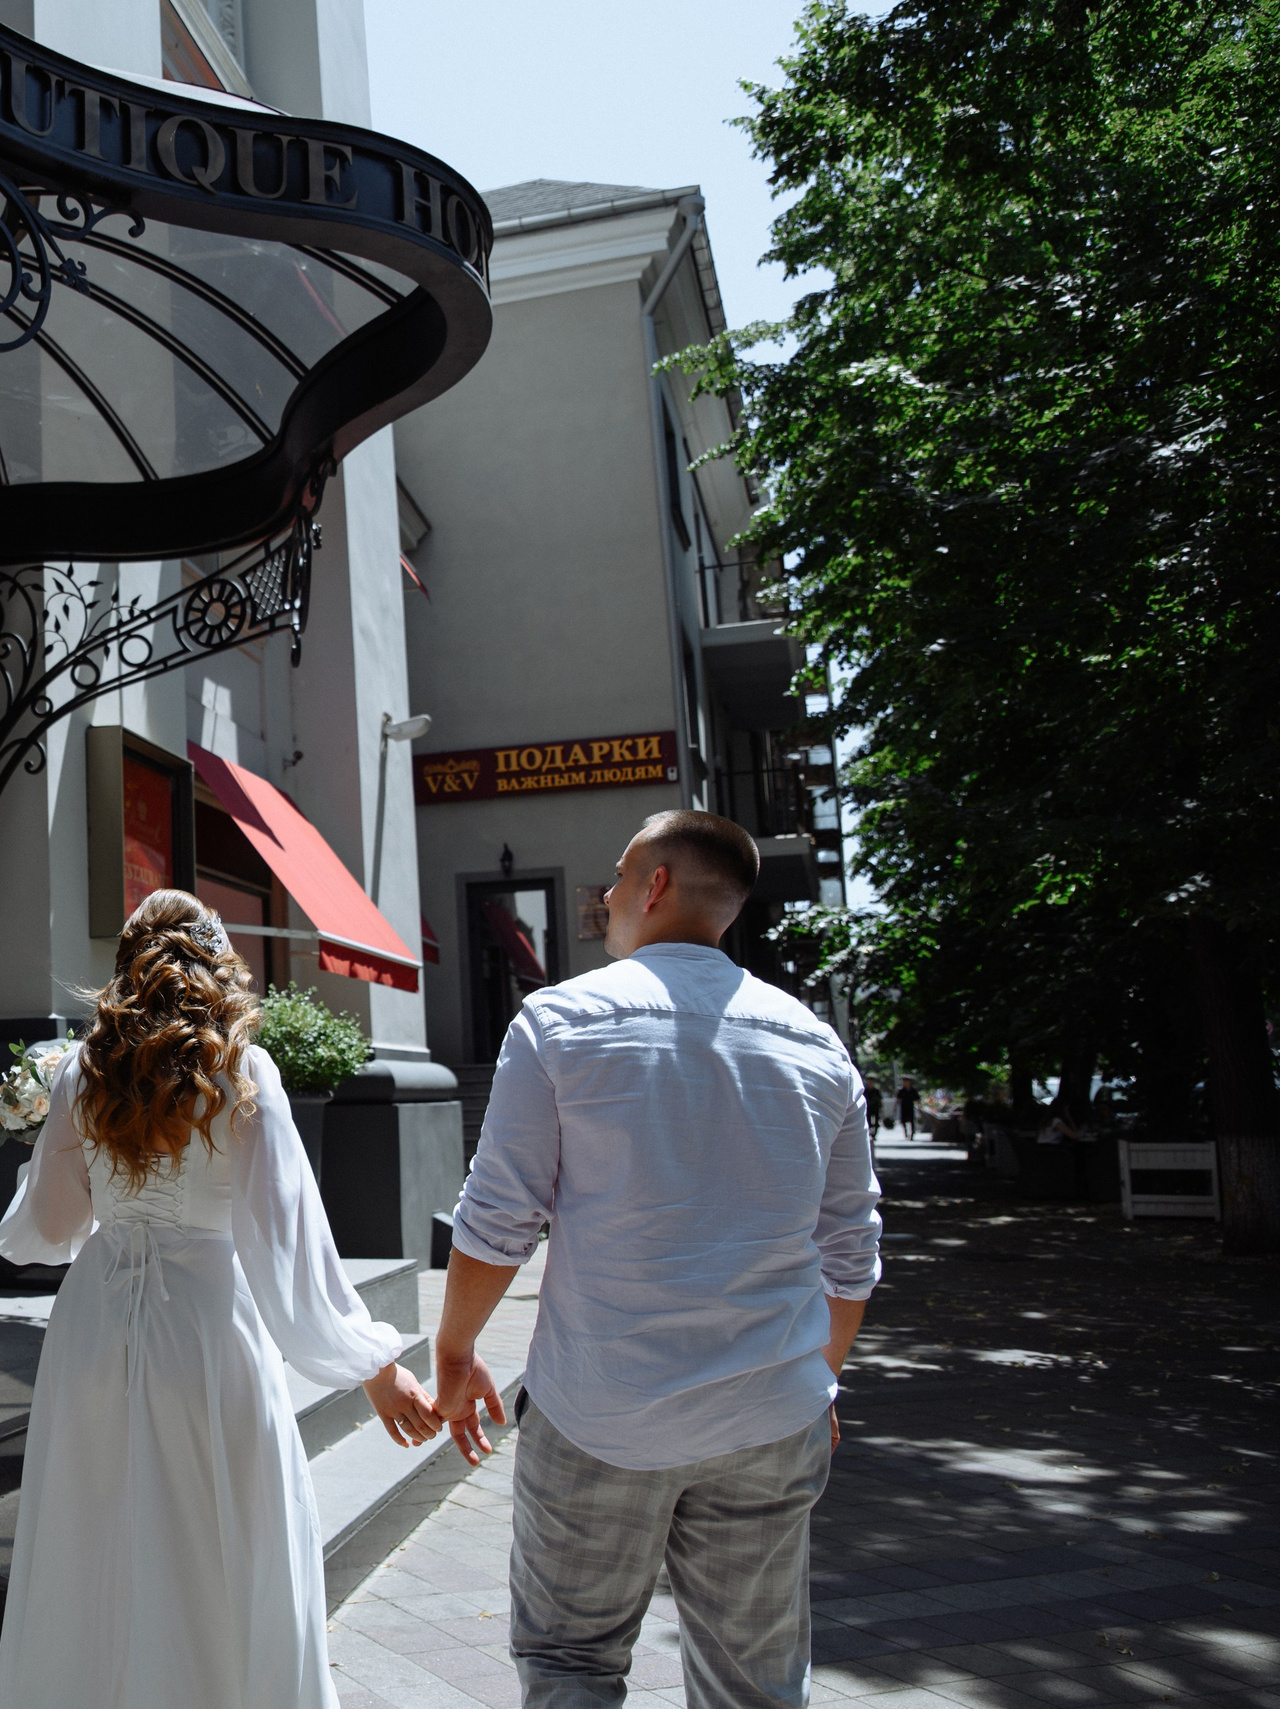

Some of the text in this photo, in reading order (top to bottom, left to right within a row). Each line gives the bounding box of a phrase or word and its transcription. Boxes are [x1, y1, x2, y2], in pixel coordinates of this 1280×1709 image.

[494, 736, 662, 773] ПОДАРКИ
[424, 771, 480, 794] V&V
[496, 764, 664, 793] ВАЖНЫМ ЛЮДЯМ
